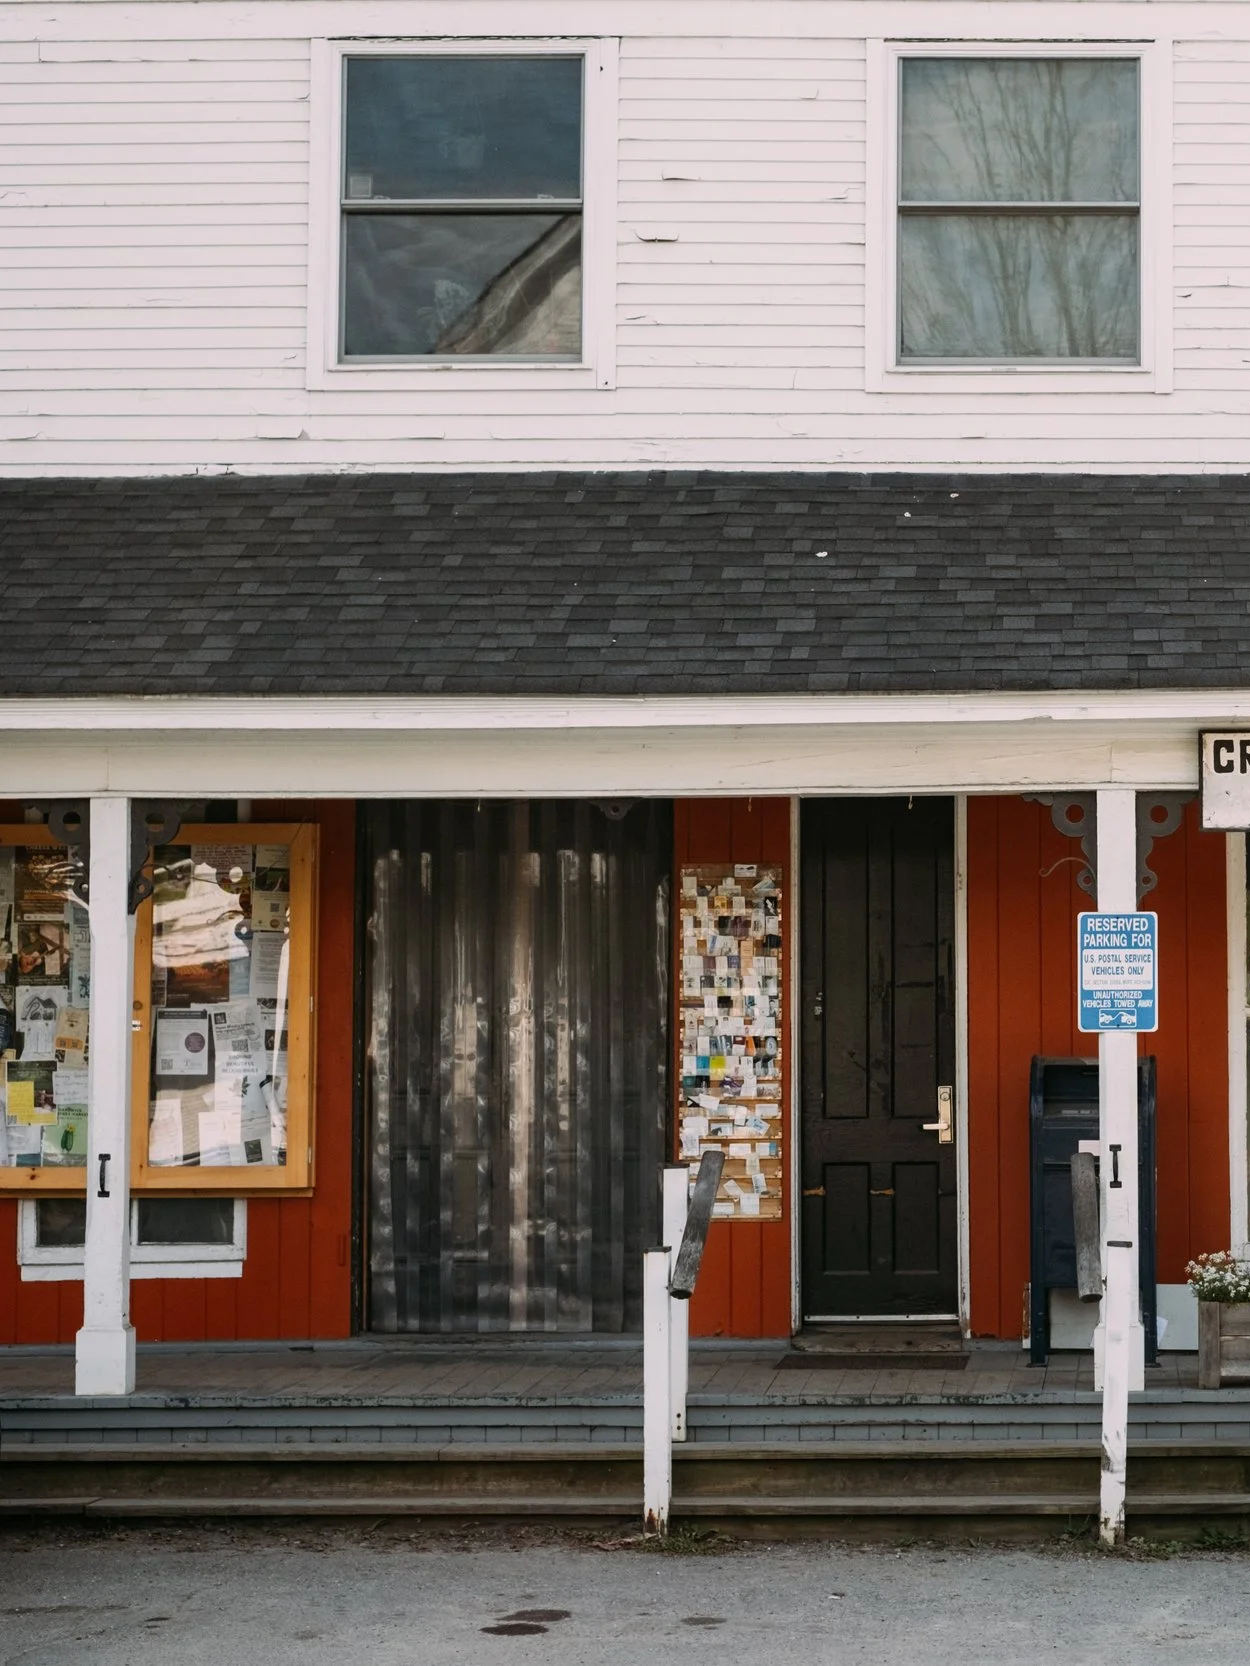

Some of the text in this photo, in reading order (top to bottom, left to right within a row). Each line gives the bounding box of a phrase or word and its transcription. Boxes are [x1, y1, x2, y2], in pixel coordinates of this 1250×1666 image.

[1087, 918, 1148, 931] RESERVED
[1084, 933, 1152, 947] PARKING FOR
[1084, 954, 1152, 963] U.S. POSTAL SERVICE
[1091, 967, 1144, 975] VEHICLES ONLY
[1093, 991, 1142, 999] UNAUTHORIZED
[1083, 1000, 1153, 1008] VEHICLES TOWED AWAY
